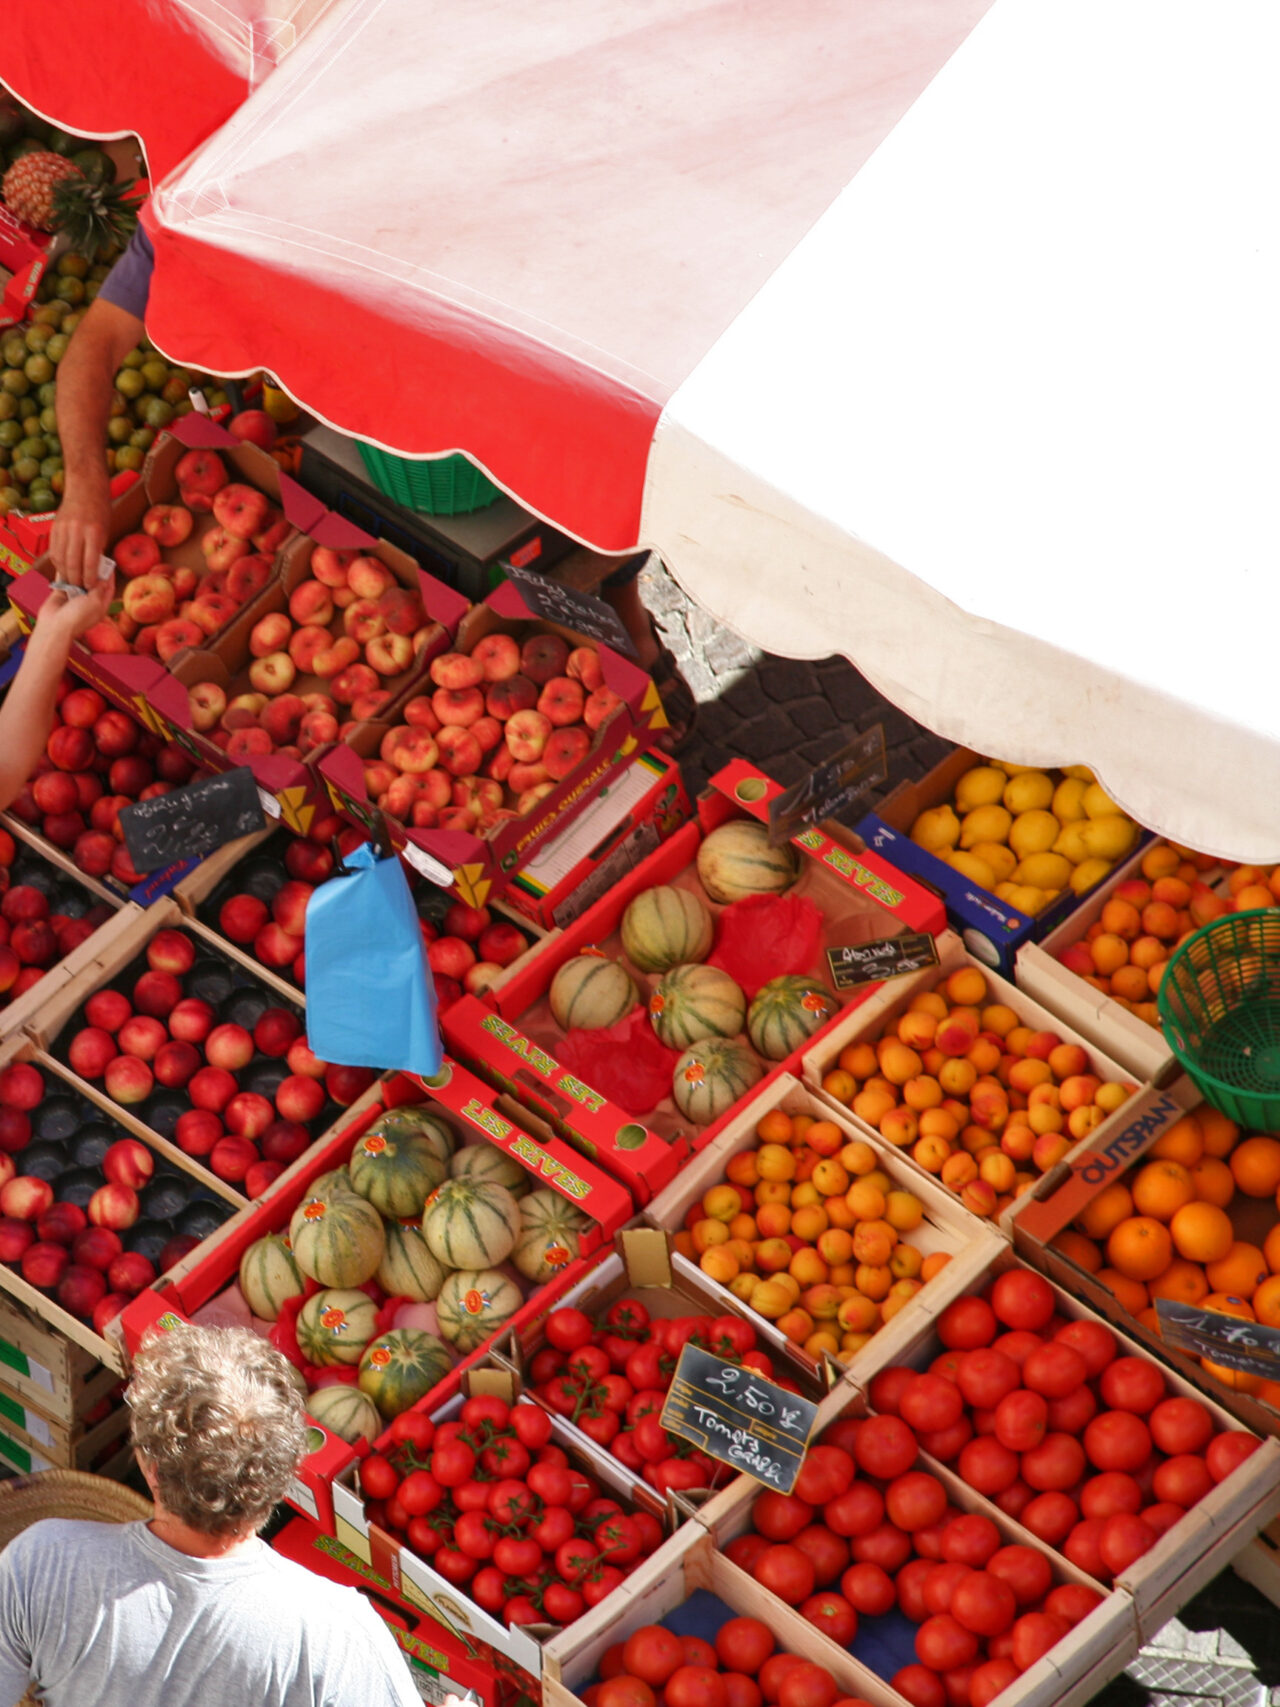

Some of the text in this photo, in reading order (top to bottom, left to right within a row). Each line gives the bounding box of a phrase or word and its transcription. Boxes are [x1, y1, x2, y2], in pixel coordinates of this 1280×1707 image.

[822, 845, 906, 908] RIVES
[480, 1013, 560, 1077] RIVES
[557, 1073, 608, 1113] LES
[461, 1097, 513, 1140] LES
[510, 1134, 593, 1200] RIVES
[1082, 1098, 1178, 1184] OUTSPAN
